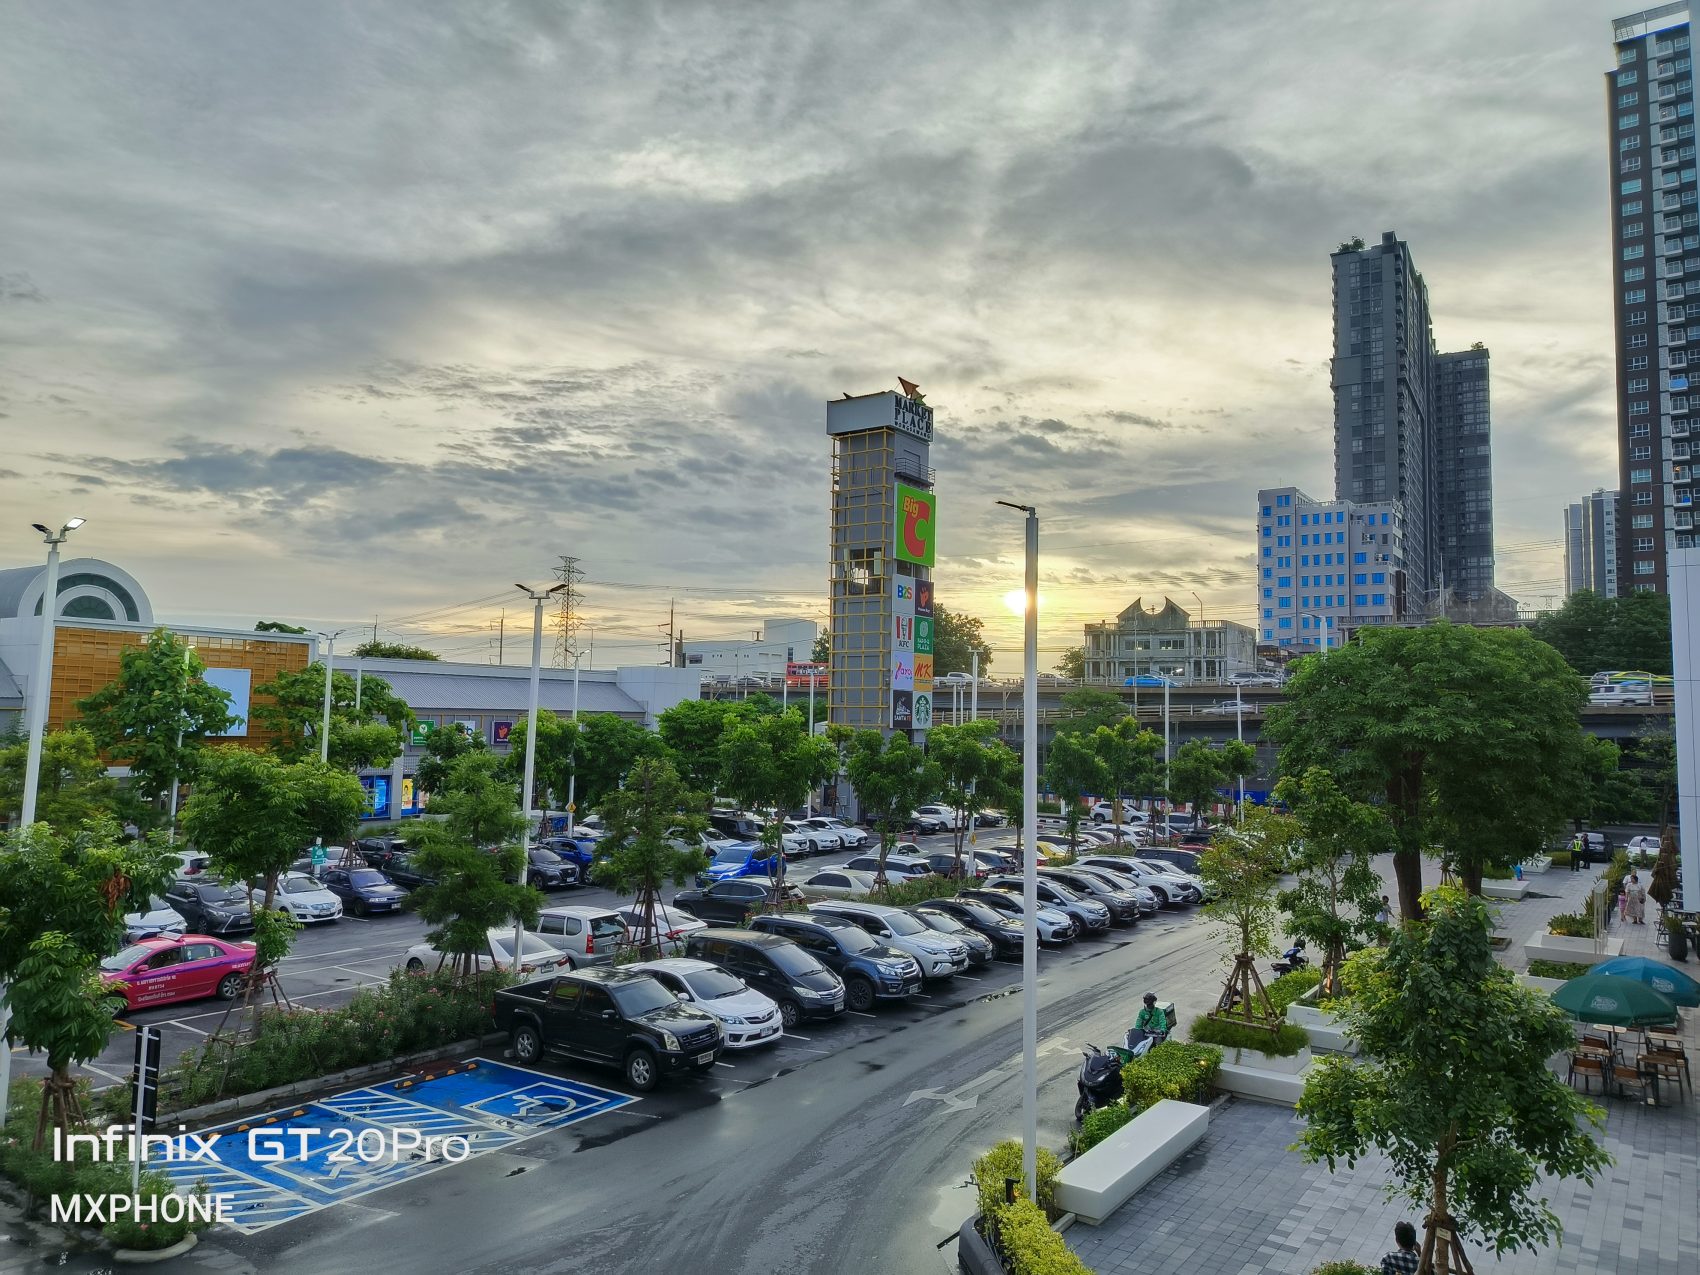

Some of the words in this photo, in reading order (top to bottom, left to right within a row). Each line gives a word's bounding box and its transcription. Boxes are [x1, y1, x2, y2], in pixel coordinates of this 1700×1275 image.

[895, 395, 932, 420] MARKET
[895, 407, 931, 433] PLACE
[904, 496, 919, 518] Big
[904, 500, 930, 557] C
[898, 584, 912, 599] B2S
[899, 640, 909, 648] KFC
[915, 662, 931, 678] MK
